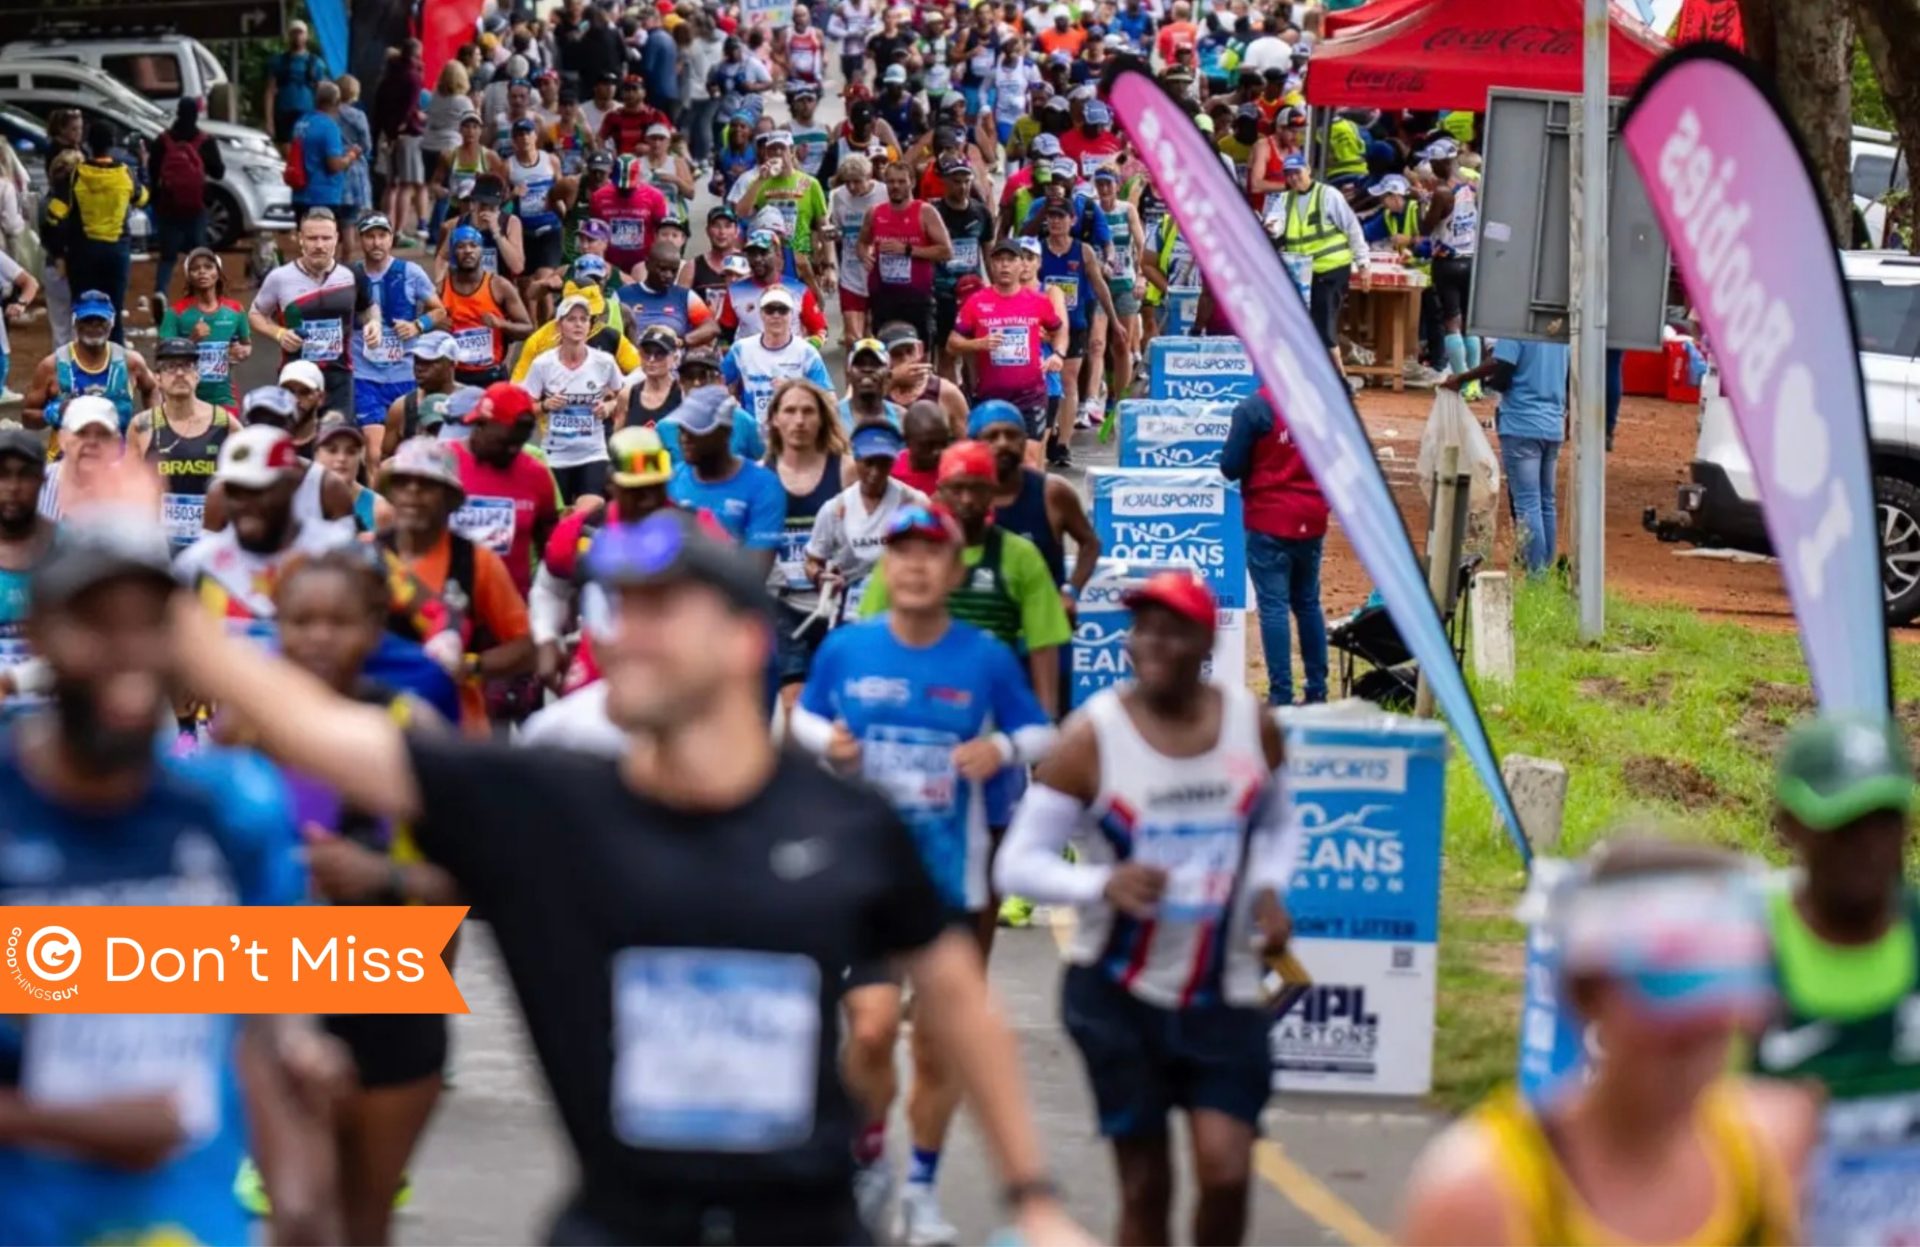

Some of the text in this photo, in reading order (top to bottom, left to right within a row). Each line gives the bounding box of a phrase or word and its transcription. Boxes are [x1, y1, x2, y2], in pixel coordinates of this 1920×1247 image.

[1172, 357, 1247, 370] TOTALSPORTS
[1164, 380, 1215, 398] TWO
[158, 458, 217, 476] BRASIL
[1121, 492, 1214, 508] TOTALSPORTS
[1110, 521, 1176, 543] TWO
[1110, 544, 1225, 566] OCEANS
[1296, 838, 1404, 873] EANS
